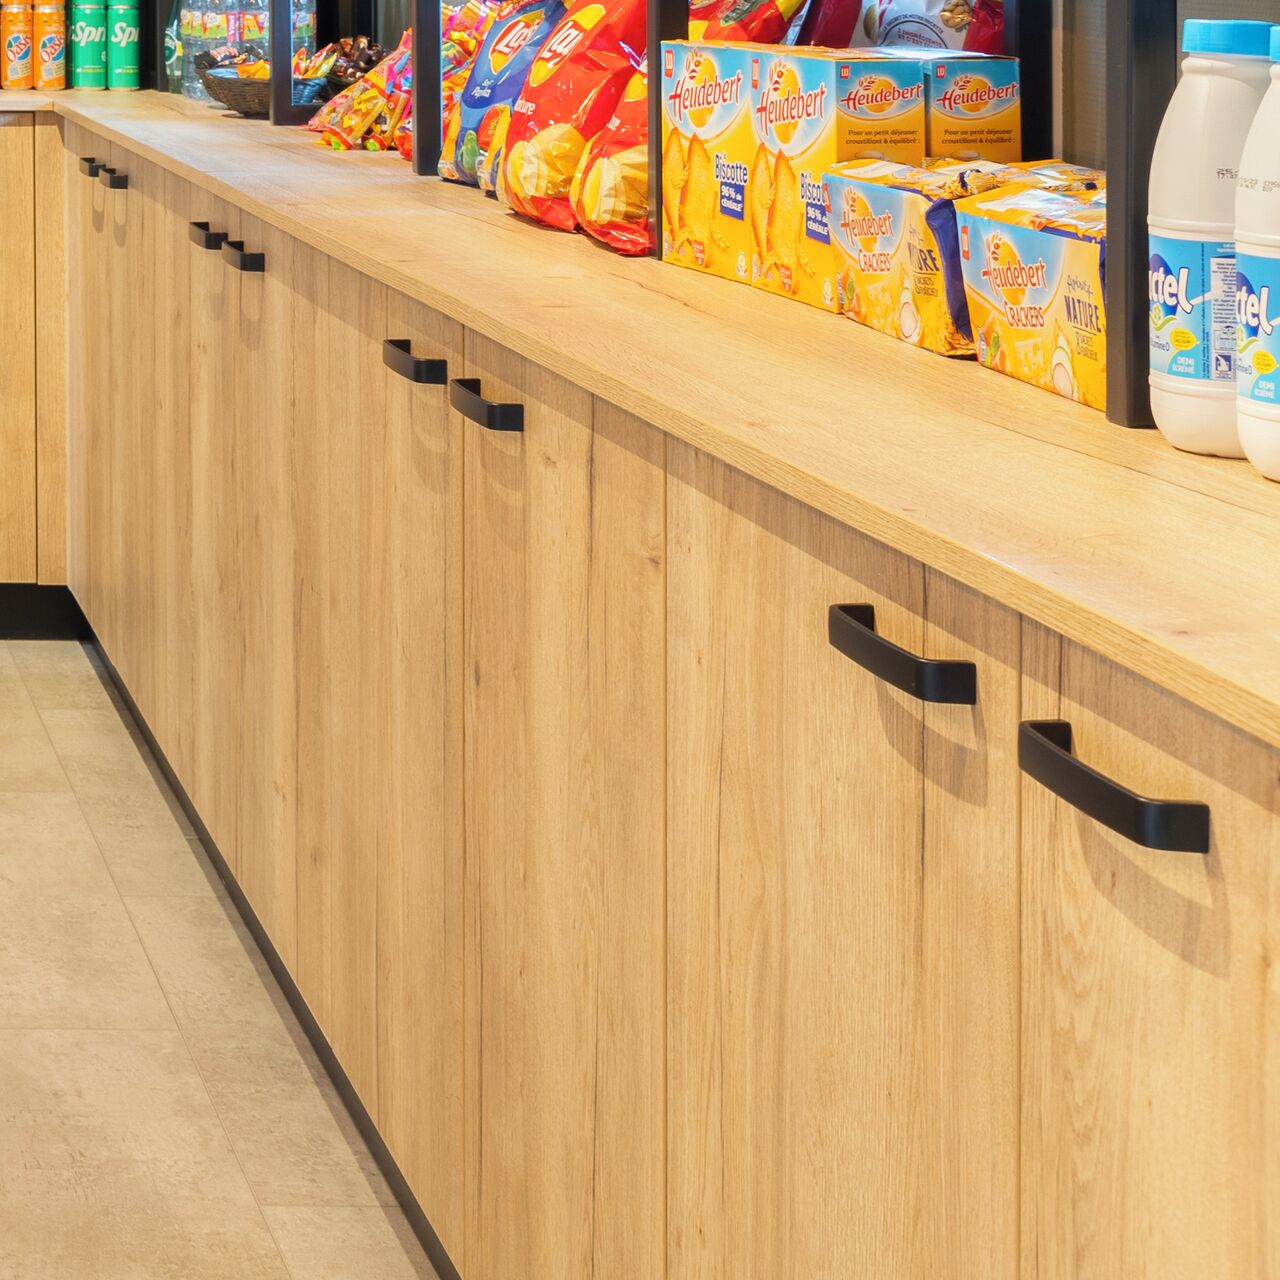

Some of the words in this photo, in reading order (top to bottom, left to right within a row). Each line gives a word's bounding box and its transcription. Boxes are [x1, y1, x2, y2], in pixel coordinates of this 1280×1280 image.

[7, 34, 31, 63] Oasis
[669, 71, 742, 121] Heudebert
[756, 85, 827, 135] Heudebert
[841, 83, 923, 111] Heudebert
[937, 83, 1018, 111] Heudebert
[875, 129, 889, 137] petit
[891, 129, 918, 137] déjeuner
[715, 154, 748, 183] Biscotte
[841, 205, 893, 246] Heudebert
[857, 250, 890, 272] CRACKERS
[982, 239, 1047, 296] Heudebert
[1004, 302, 1044, 328] CRACKERS
[1064, 295, 1101, 333] NATURE
